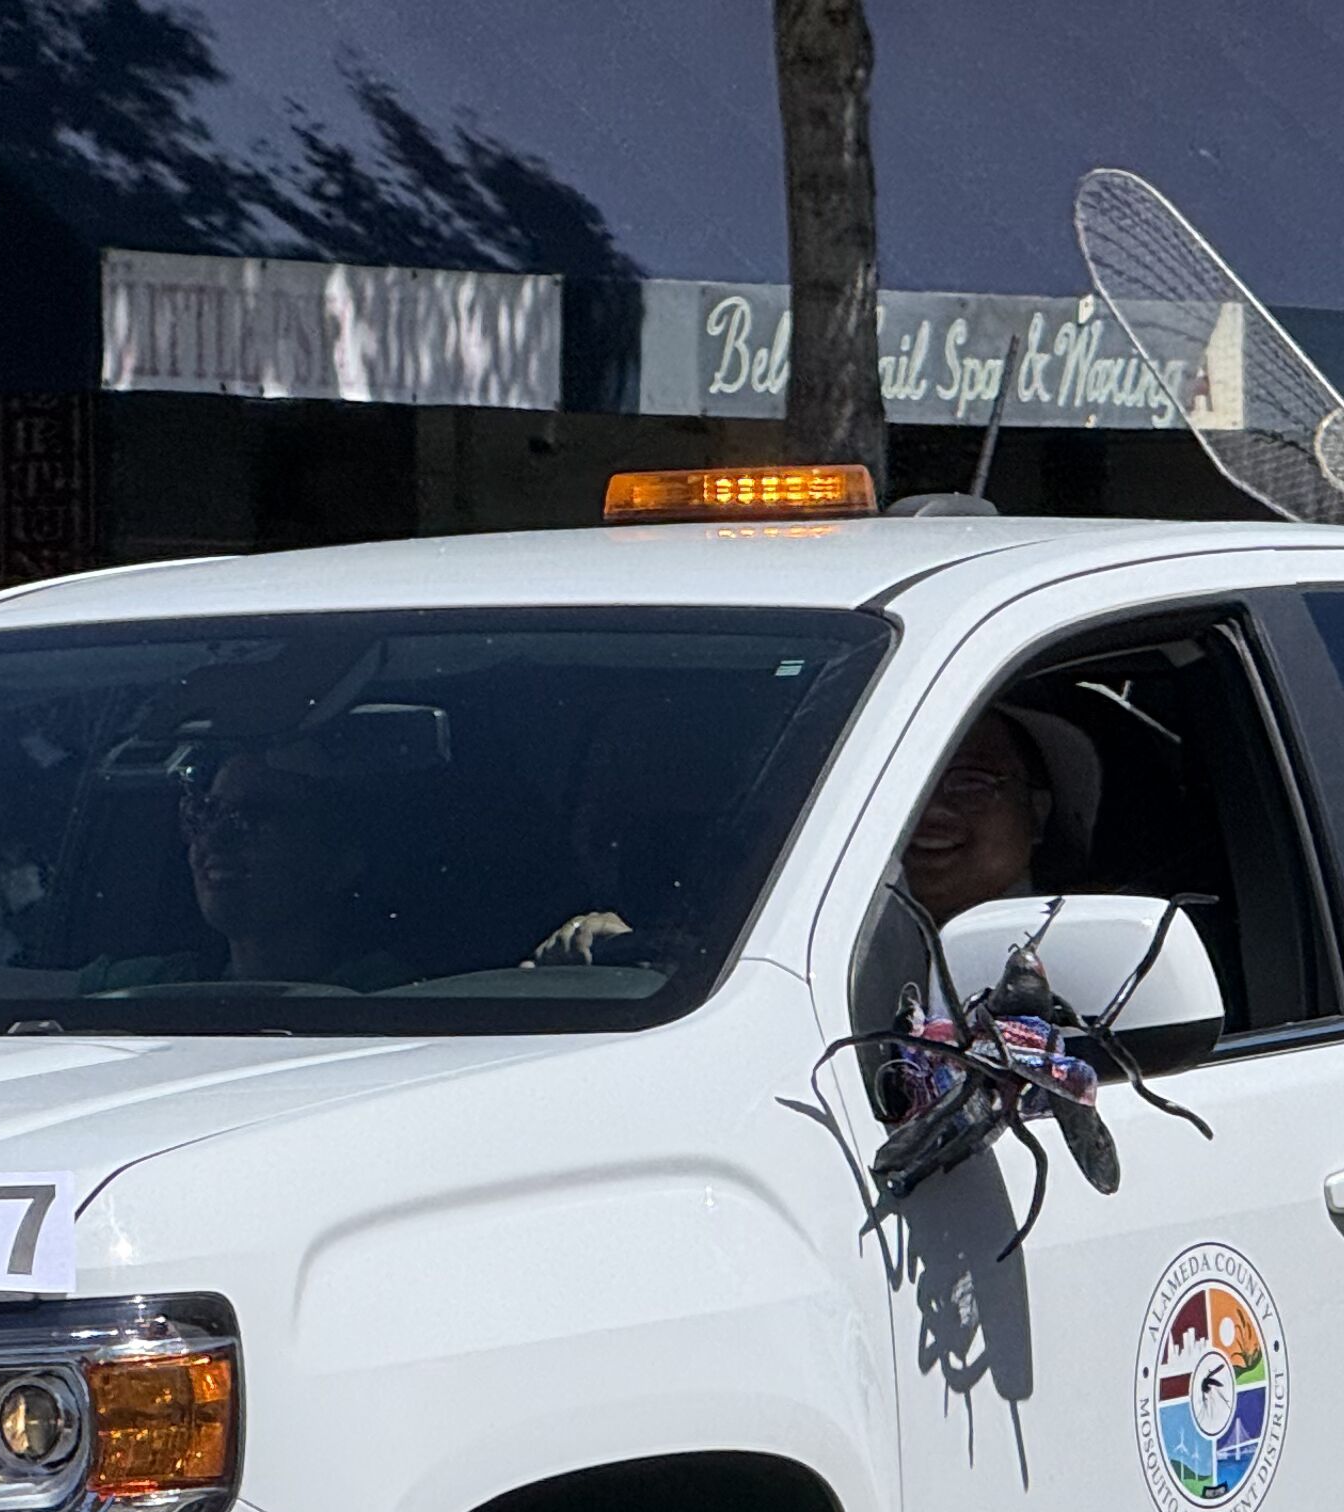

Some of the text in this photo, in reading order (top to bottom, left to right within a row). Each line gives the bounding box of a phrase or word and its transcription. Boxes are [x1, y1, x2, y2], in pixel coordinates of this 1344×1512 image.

[936, 318, 1003, 418] Spa
[1019, 312, 1051, 402] &
[1055, 317, 1185, 427] Waxing
[1149, 1252, 1273, 1343] ALAMEDA COUNTY
[1258, 1368, 1285, 1486] DISTRICT
